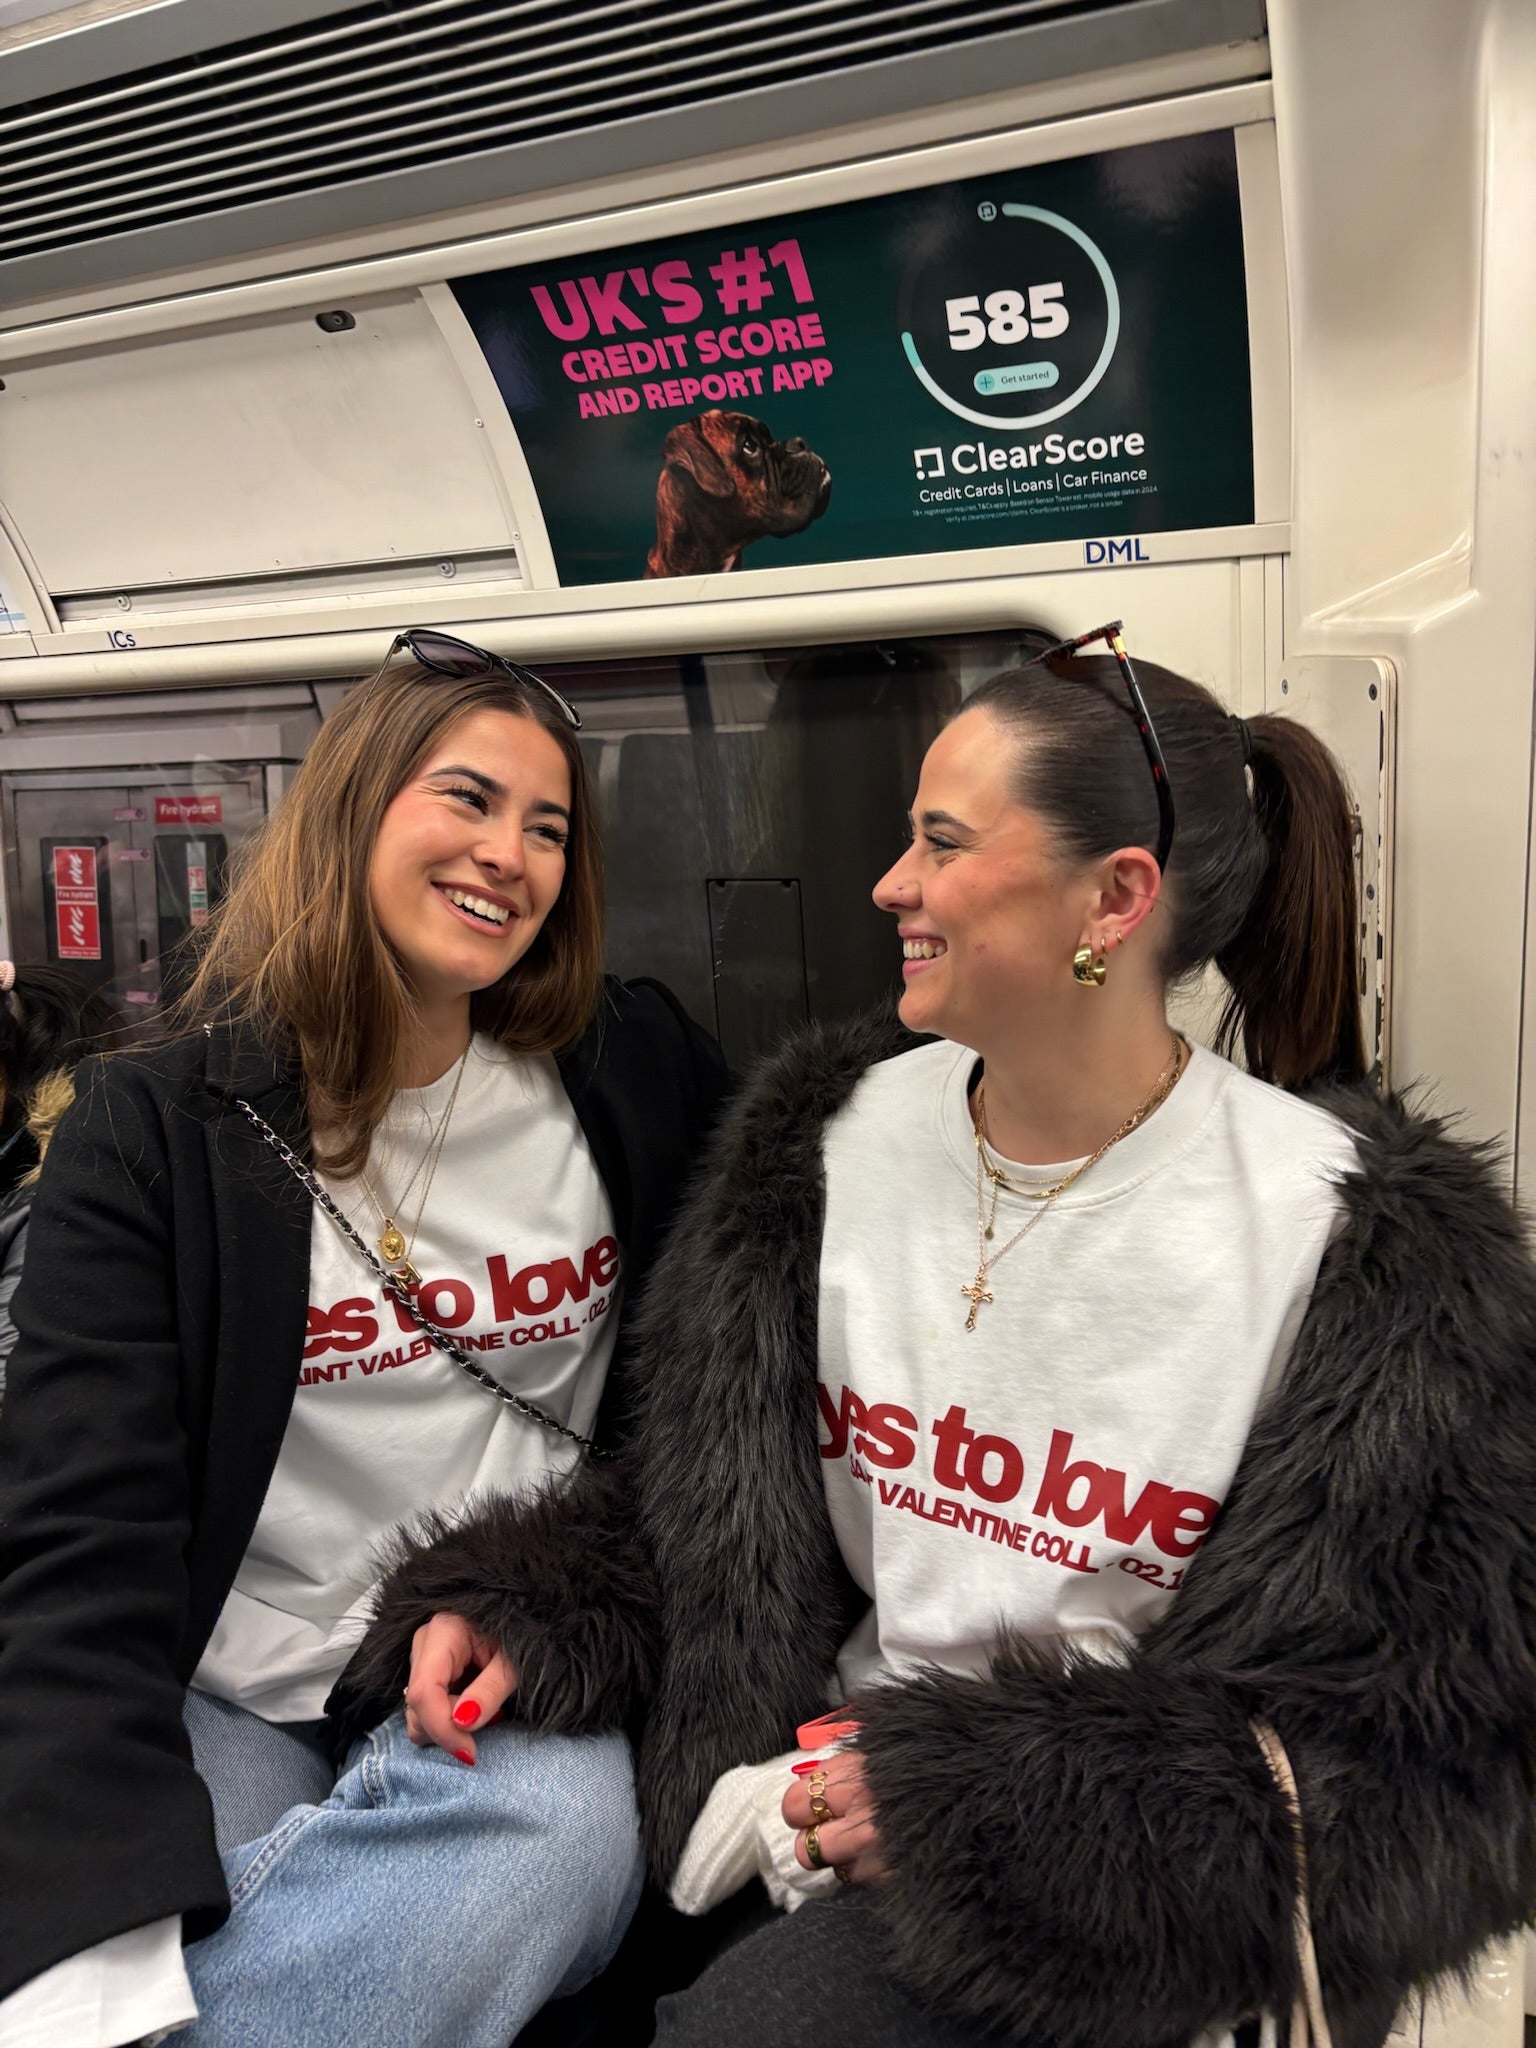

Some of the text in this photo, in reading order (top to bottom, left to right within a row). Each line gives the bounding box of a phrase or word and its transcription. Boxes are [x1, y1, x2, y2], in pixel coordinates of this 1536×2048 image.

[529, 238, 815, 342] UK'S #1
[945, 281, 1070, 352] 585
[561, 312, 827, 384] CREDIT SCORE
[1000, 370, 1050, 386] Get started
[577, 357, 834, 420] AND REPORT APP
[951, 431, 1146, 475] ClearScore
[919, 487, 962, 503] Credit
[963, 481, 1004, 498] Cards
[1012, 476, 1054, 494] Loans
[1062, 473, 1089, 488] Car
[1091, 468, 1148, 485] Finance
[1085, 537, 1150, 566] DML
[106, 630, 136, 649] ICs
[160, 803, 217, 817] Fire hydrant
[301, 1235, 619, 1360] es to love
[357, 1332, 505, 1377] VALENINE
[509, 1316, 581, 1347] COLL
[816, 1383, 1221, 1558] yes to love
[878, 1478, 1032, 1553] VALENTINE
[1031, 1530, 1101, 1574] COLL
